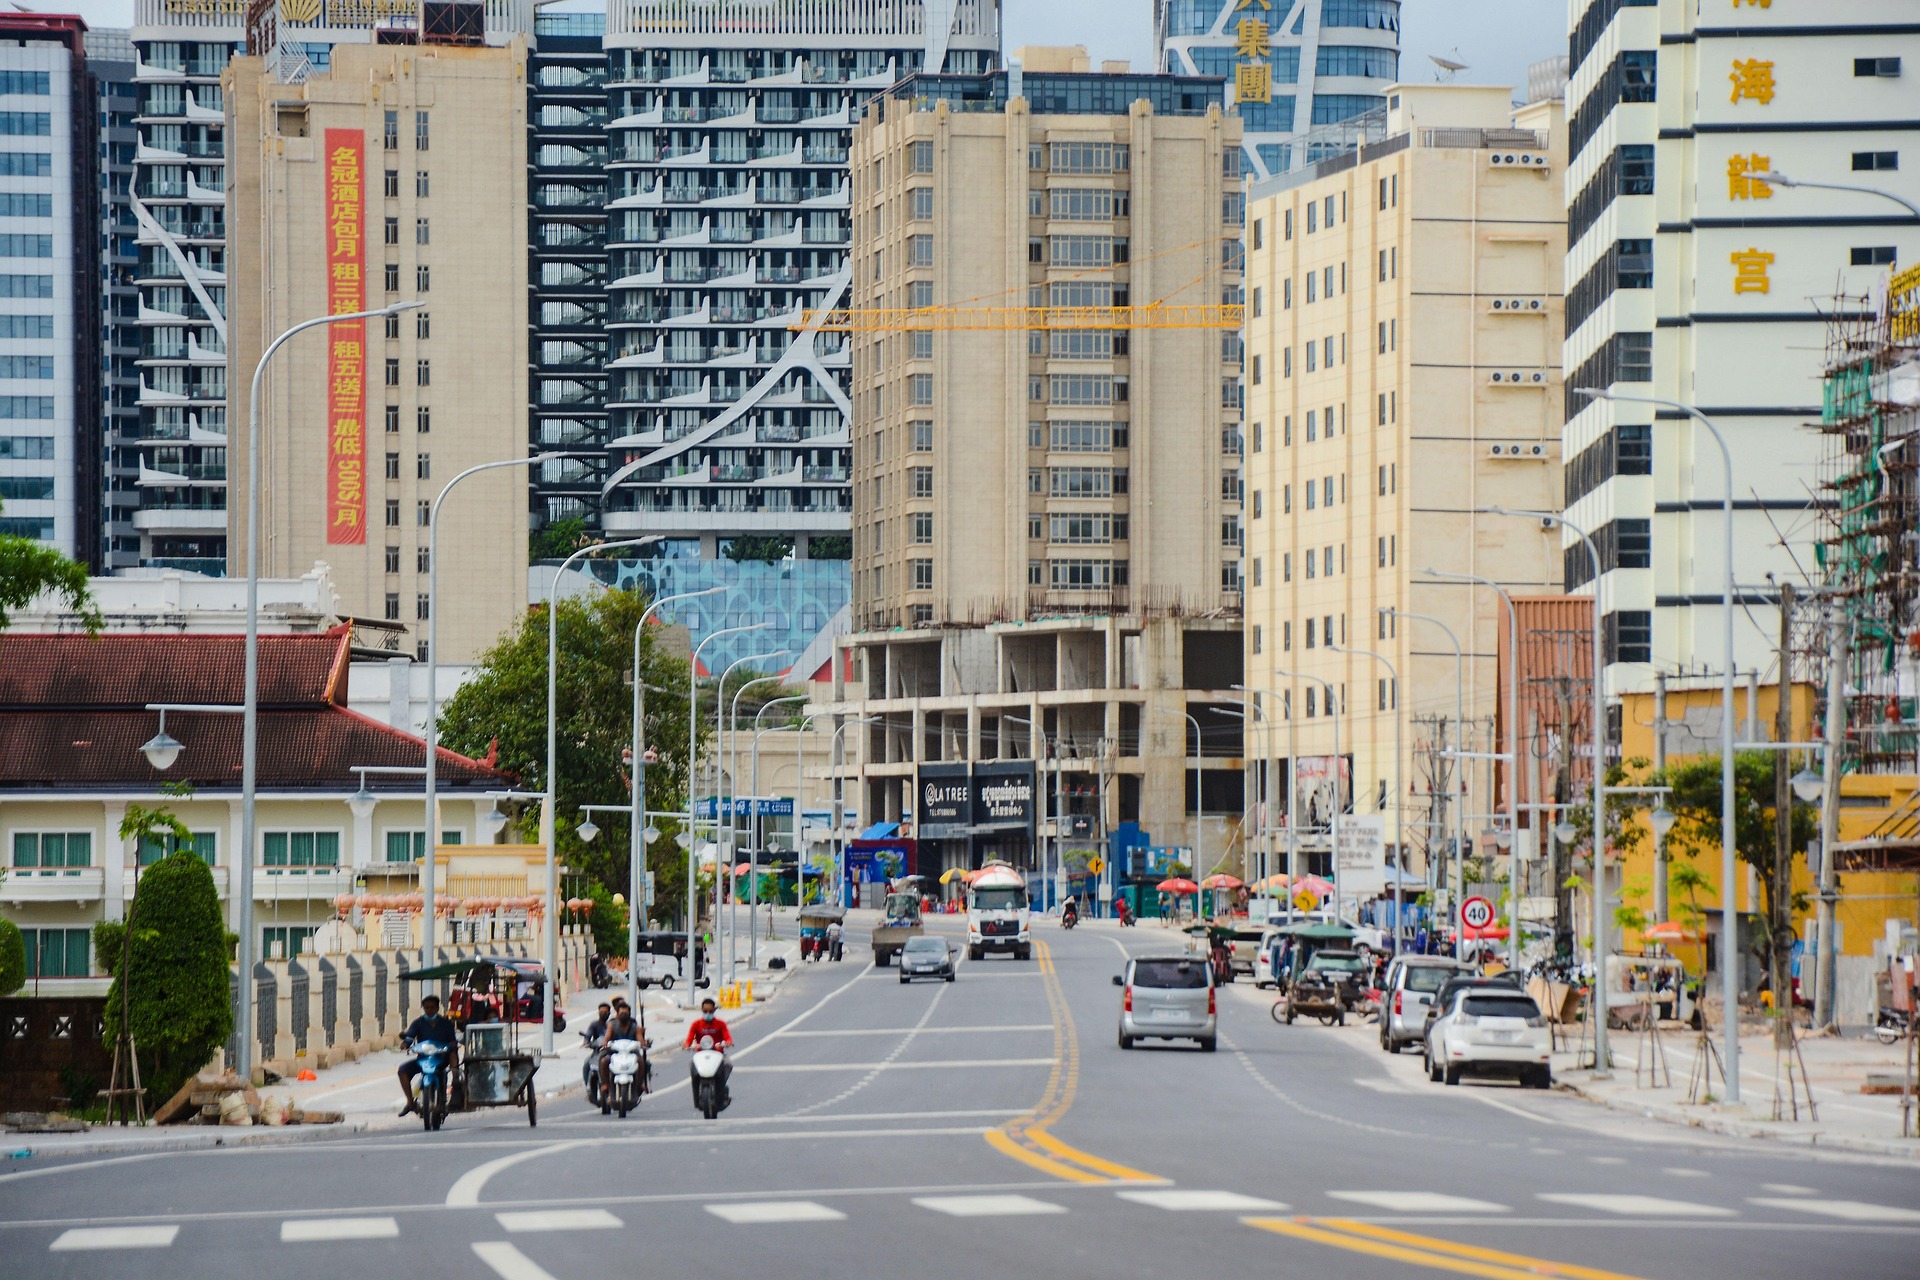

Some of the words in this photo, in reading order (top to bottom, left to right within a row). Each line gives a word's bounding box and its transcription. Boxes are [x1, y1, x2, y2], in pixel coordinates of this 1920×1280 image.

[331, 146, 361, 258] 名冠酒店包月
[333, 340, 362, 413] 租五送三
[945, 786, 968, 802] TREE
[1468, 906, 1486, 920] 40
